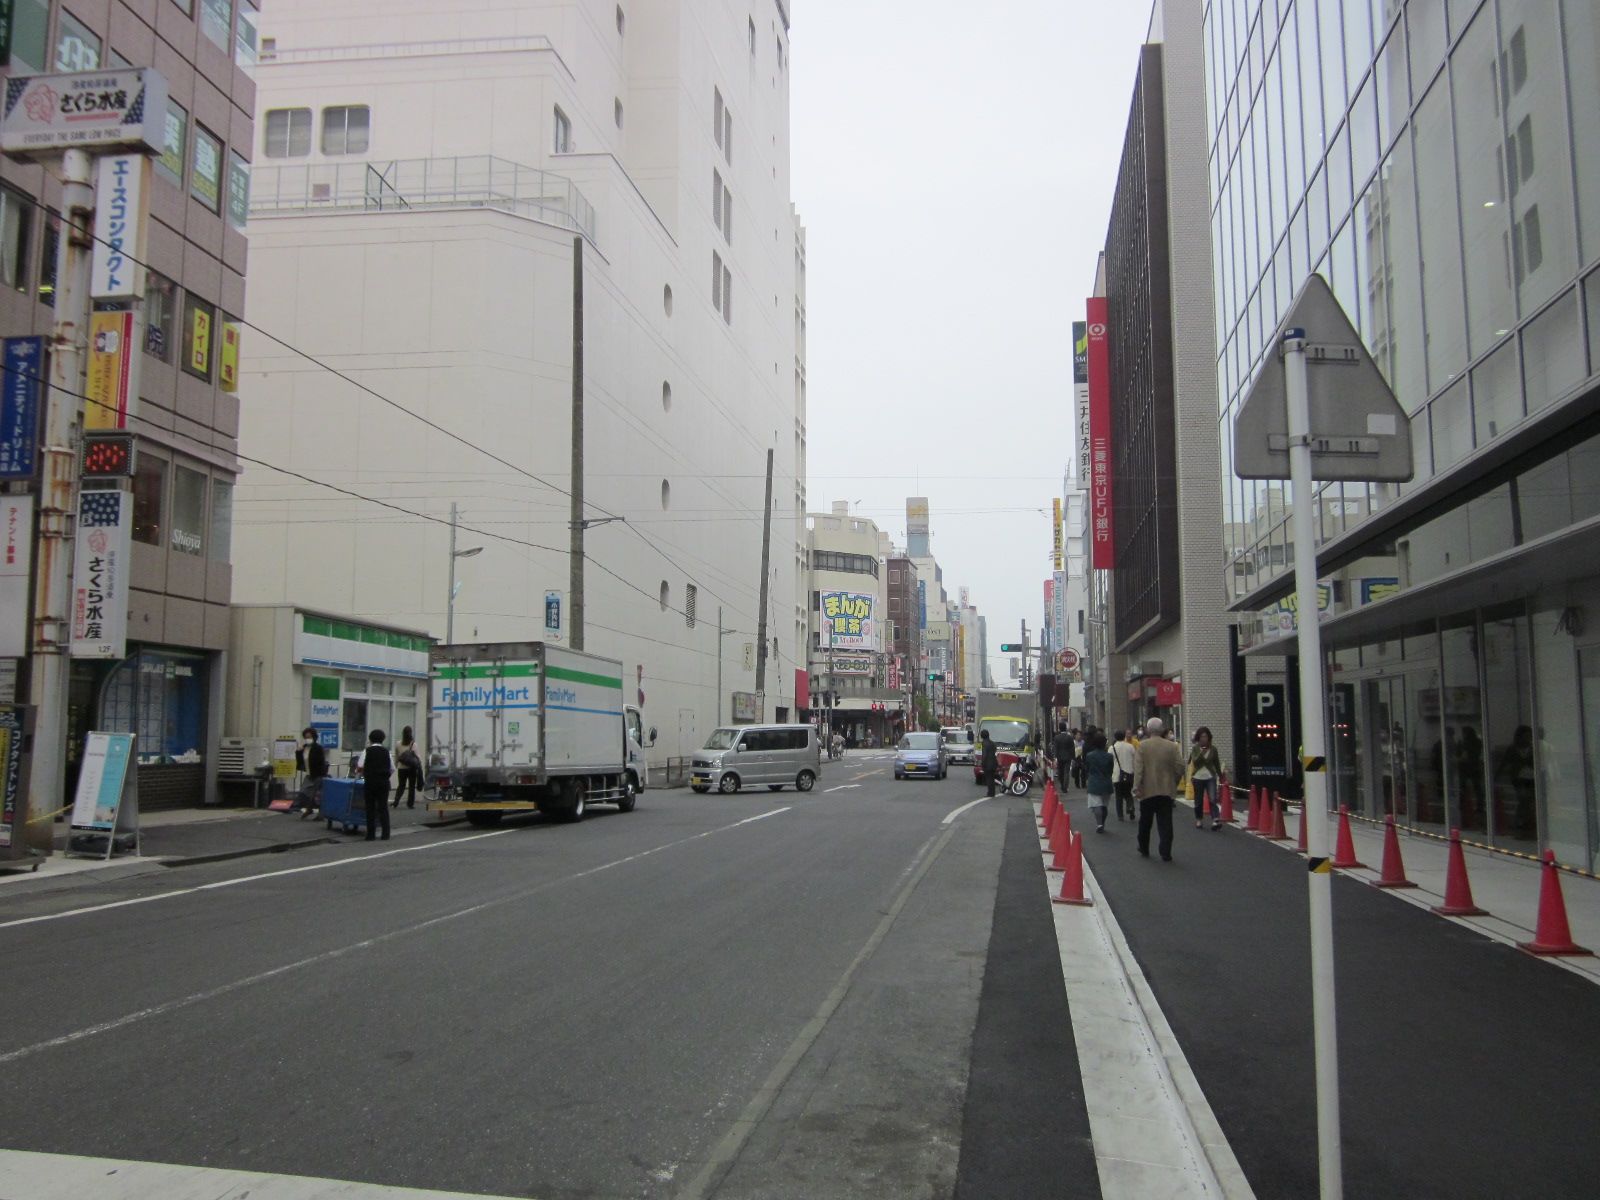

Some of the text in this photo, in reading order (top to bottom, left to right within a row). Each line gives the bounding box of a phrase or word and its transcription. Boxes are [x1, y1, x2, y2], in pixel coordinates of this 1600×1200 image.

[60, 90, 127, 113] さくら水産
[107, 159, 129, 292] エースコンタクト
[195, 314, 206, 366] カイロ
[1094, 438, 1108, 542] 三菱東京UFJ銀行
[85, 557, 104, 639] さくら水産
[825, 595, 870, 618] まんが
[442, 687, 529, 705] FamilyMart
[546, 686, 576, 704] FamilyMart
[1257, 692, 1275, 714] P
[313, 704, 339, 716] FamilyMart
